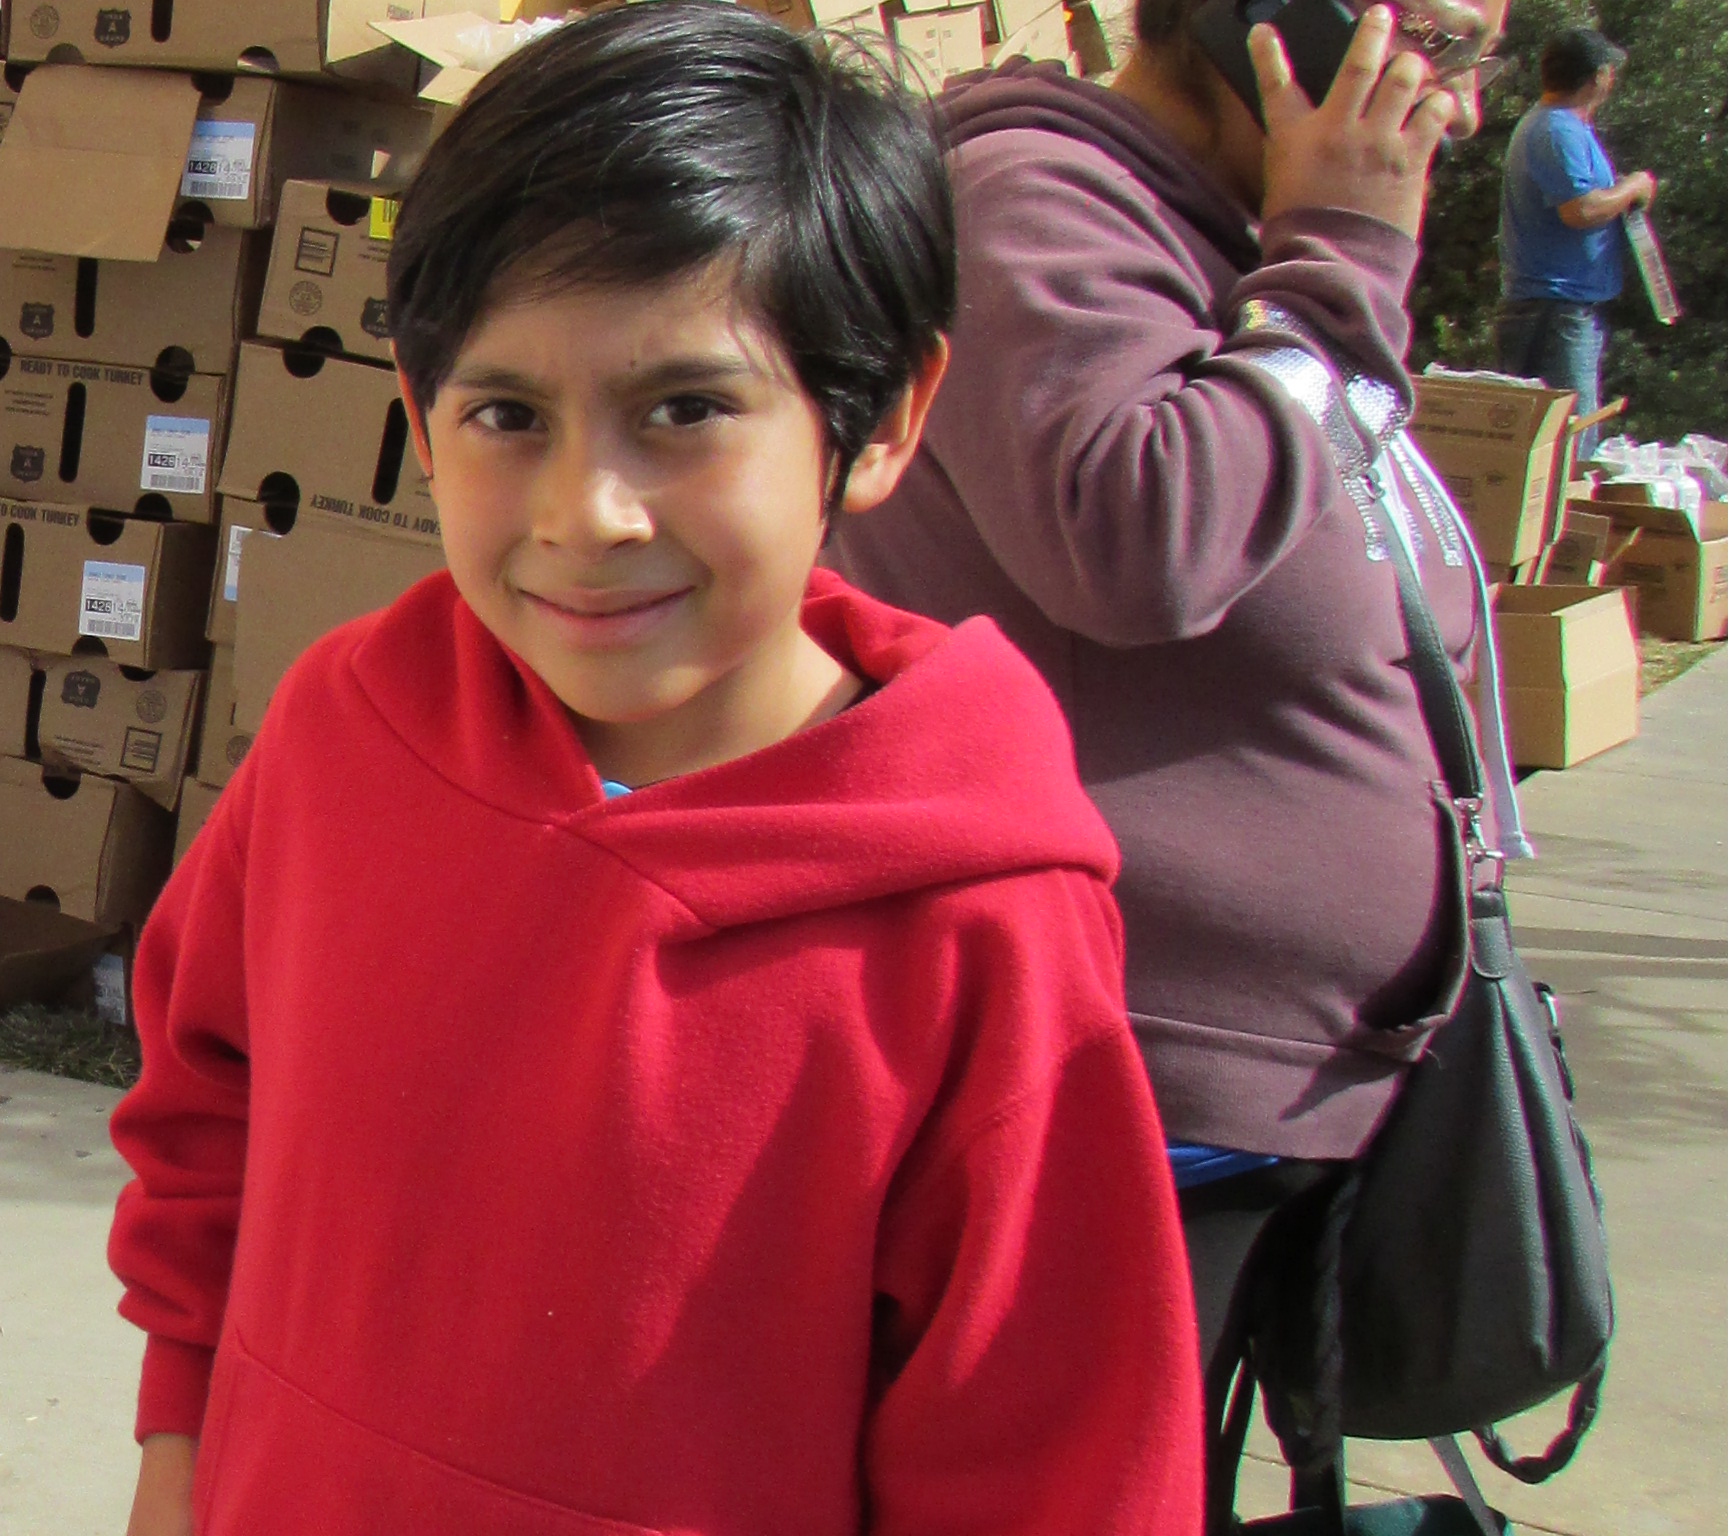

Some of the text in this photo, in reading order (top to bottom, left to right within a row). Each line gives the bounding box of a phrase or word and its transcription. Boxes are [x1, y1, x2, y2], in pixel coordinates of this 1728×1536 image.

[20, 359, 144, 386] READY TO COOK TURKEY
[10, 504, 37, 521] COOK
[41, 509, 80, 527] TURKEY
[309, 494, 443, 535] EADY TO COOK TURKEY
